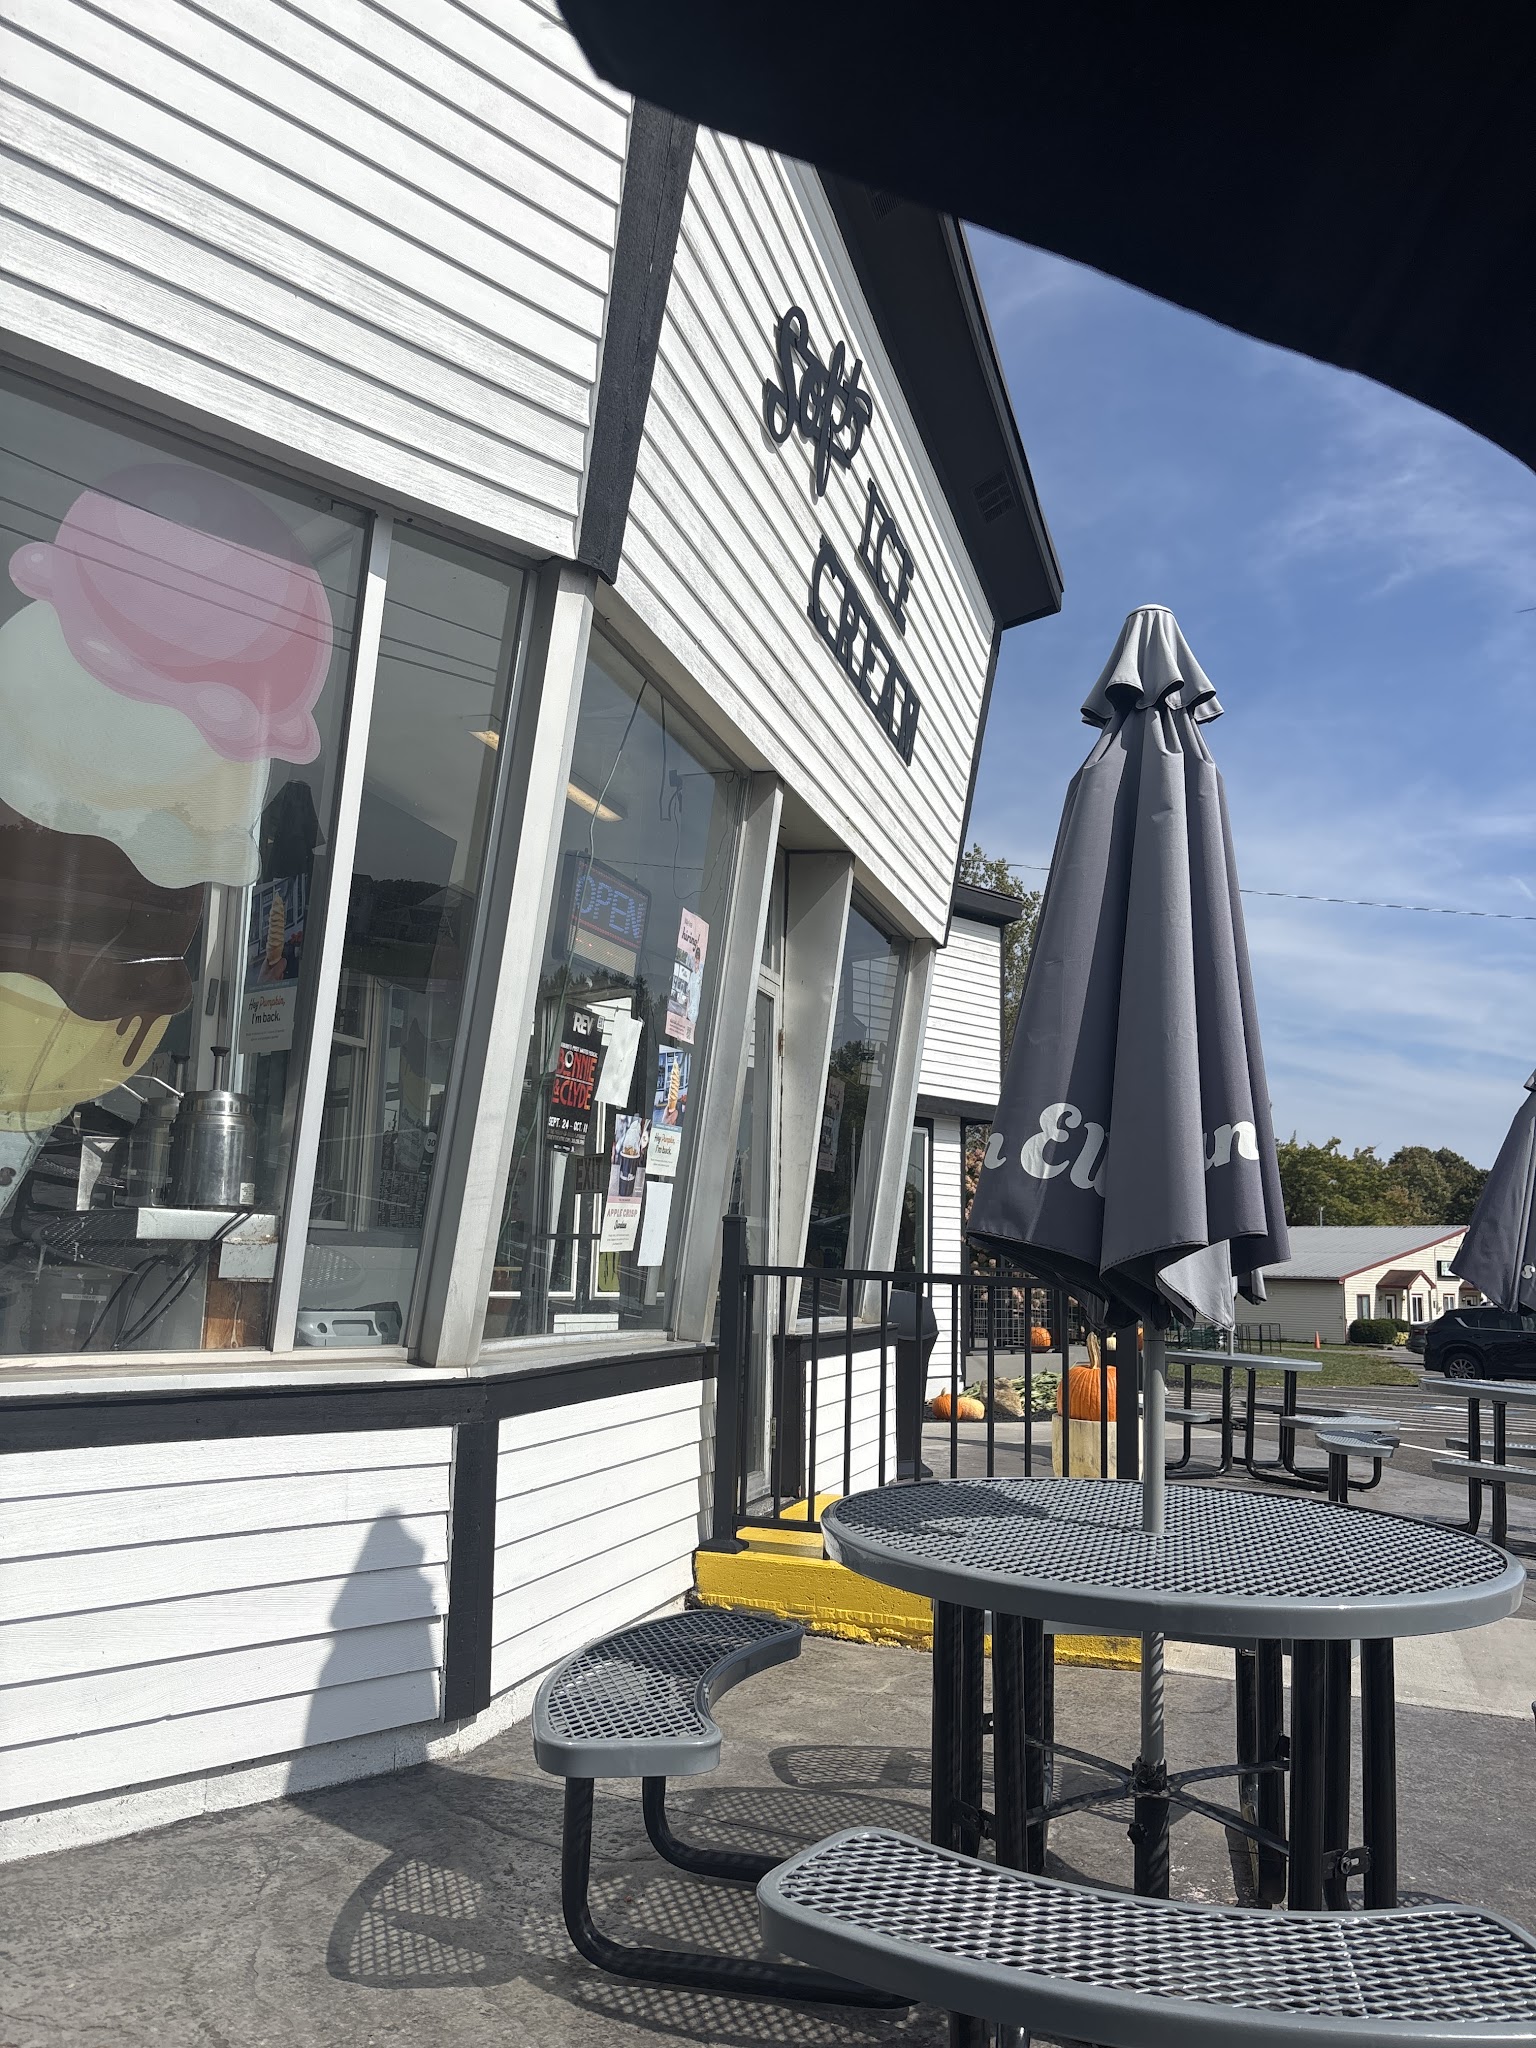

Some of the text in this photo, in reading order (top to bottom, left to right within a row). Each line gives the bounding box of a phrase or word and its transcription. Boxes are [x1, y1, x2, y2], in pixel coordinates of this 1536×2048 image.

[858, 478, 914, 637] ICE
[808, 537, 921, 767] CREAM
[575, 875, 645, 938] OPEN
[682, 926, 700, 952] hiring!
[248, 997, 259, 1012] Hey
[251, 1010, 280, 1024] I'm back.
[573, 1012, 594, 1036] REV
[557, 1047, 598, 1082] BONNIE
[552, 1079, 593, 1110] & CLYDE
[548, 1116, 561, 1128] SEPT.
[561, 1119, 570, 1129] 24
[427, 1139, 436, 1147] 30
[576, 1157, 603, 1191] EXIT
[607, 1209, 638, 1218] APPLE CRISP
